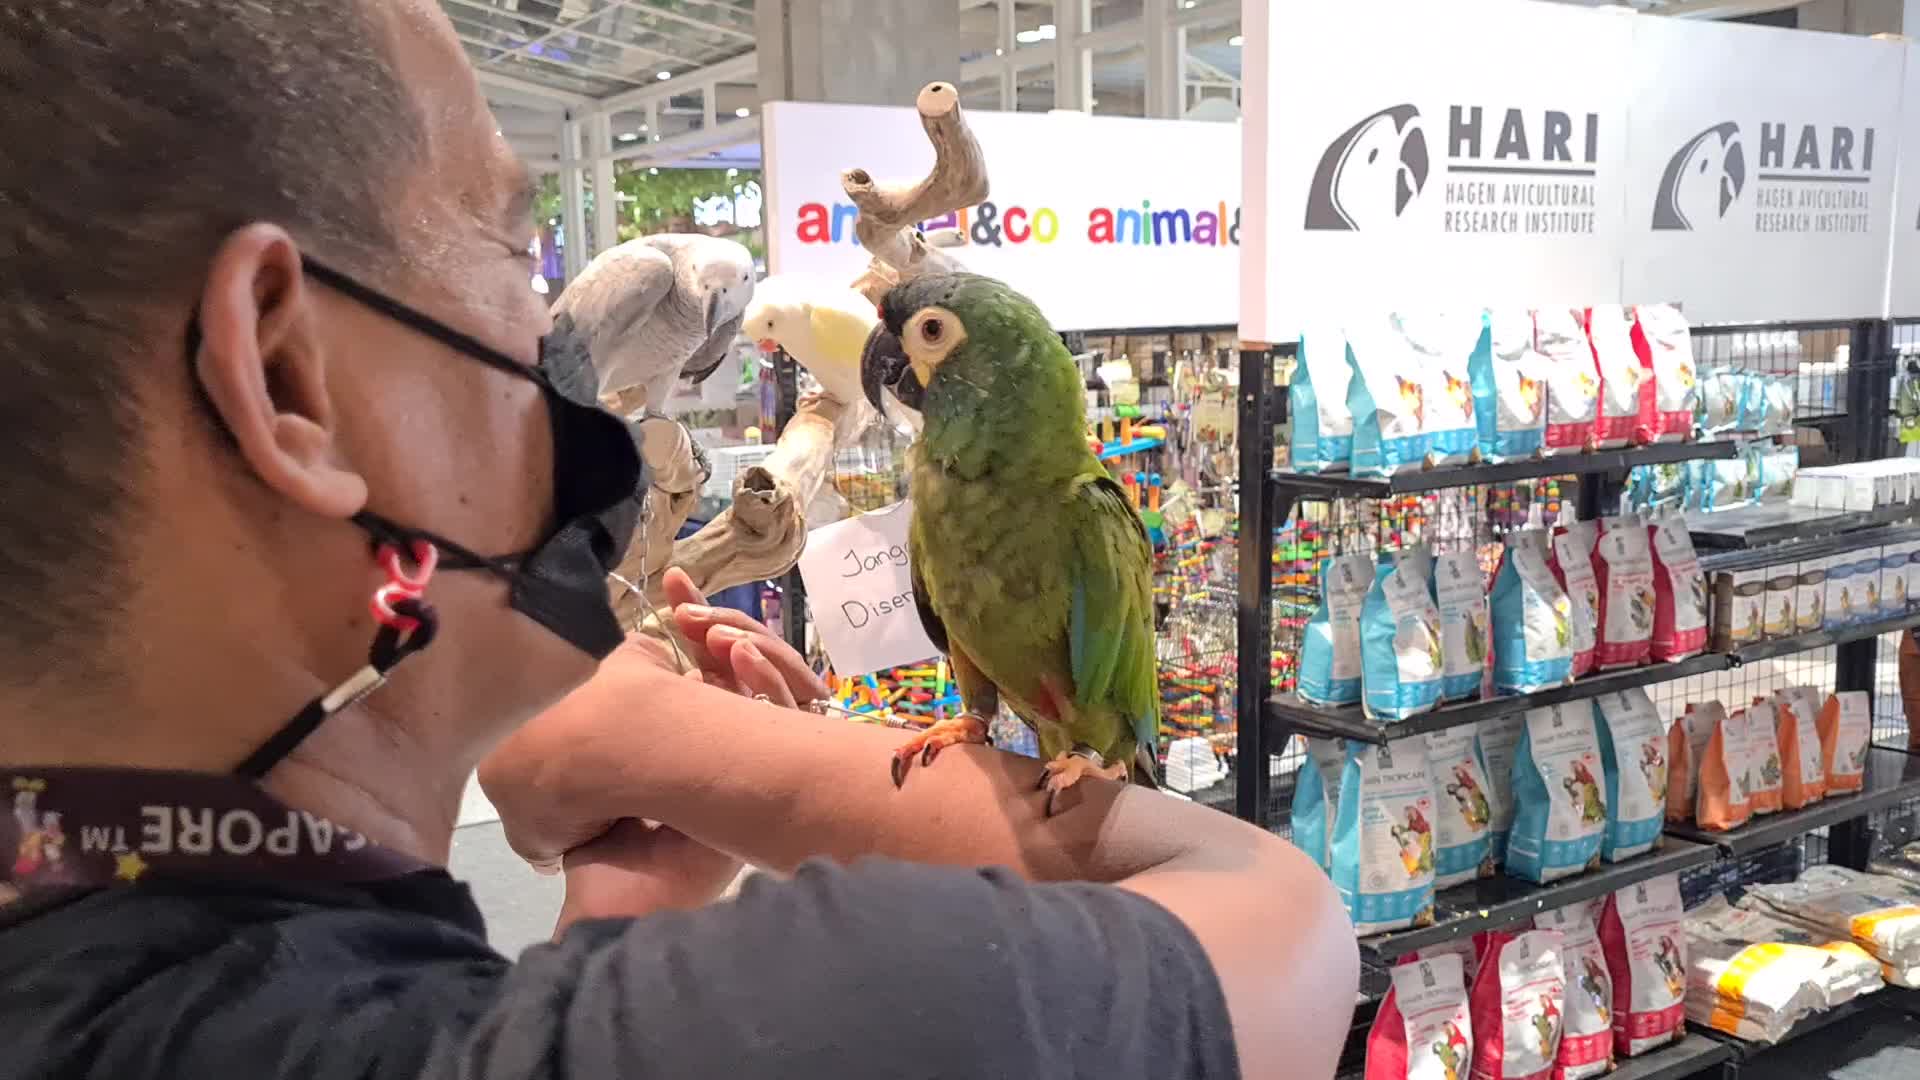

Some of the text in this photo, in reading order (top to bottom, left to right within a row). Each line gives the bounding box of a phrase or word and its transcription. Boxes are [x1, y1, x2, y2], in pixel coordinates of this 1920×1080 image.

[1448, 105, 1599, 163] HARI
[1759, 122, 1875, 171] HARI
[1446, 182, 1596, 207] HAGEN AVICULTURAL
[1757, 188, 1870, 209] HAGEN AVICULTURAL
[1445, 211, 1596, 233] RESEARCH INSTITUTE
[1755, 213, 1870, 233] RESEARCH INSTITUTE
[841, 541, 909, 578] Jang
